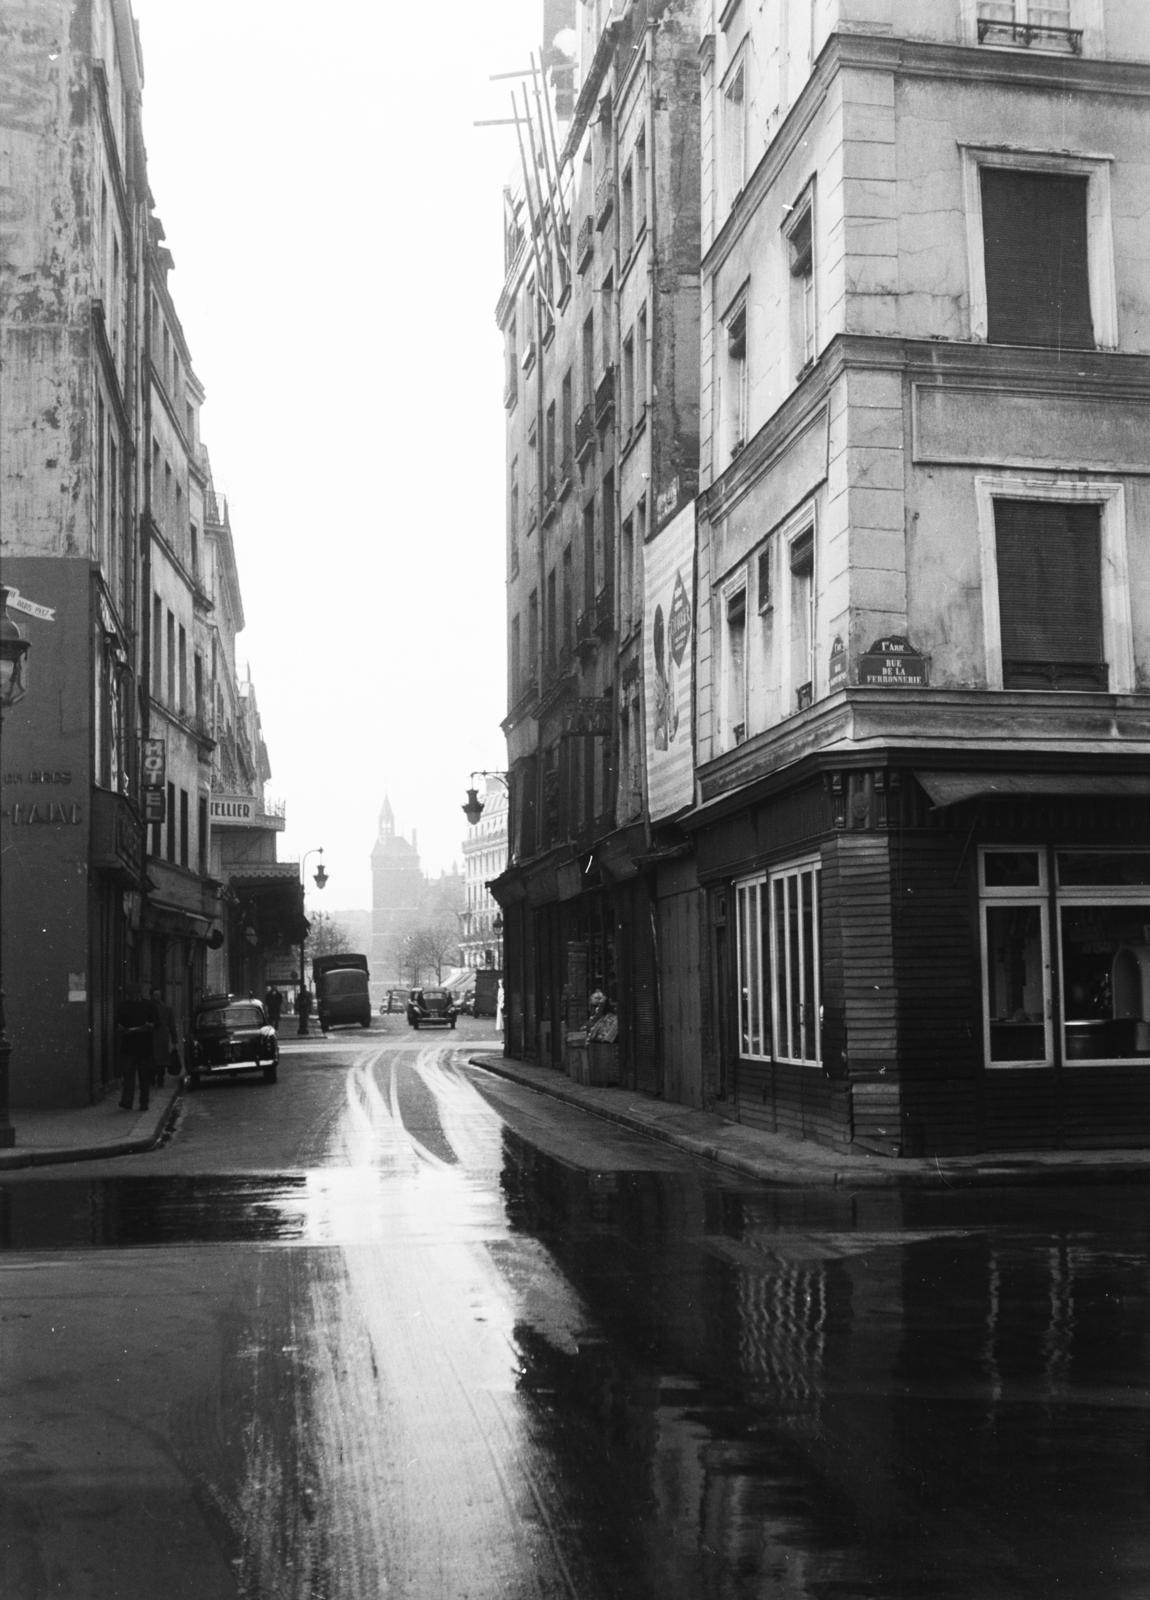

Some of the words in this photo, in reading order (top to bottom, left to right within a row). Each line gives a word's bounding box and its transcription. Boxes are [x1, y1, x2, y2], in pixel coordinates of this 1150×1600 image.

[886, 659, 902, 667] RUE
[882, 667, 893, 675] DE
[895, 667, 906, 676] LA
[866, 675, 922, 684] FERRONNERIE
[145, 741, 163, 820] HOTEL
